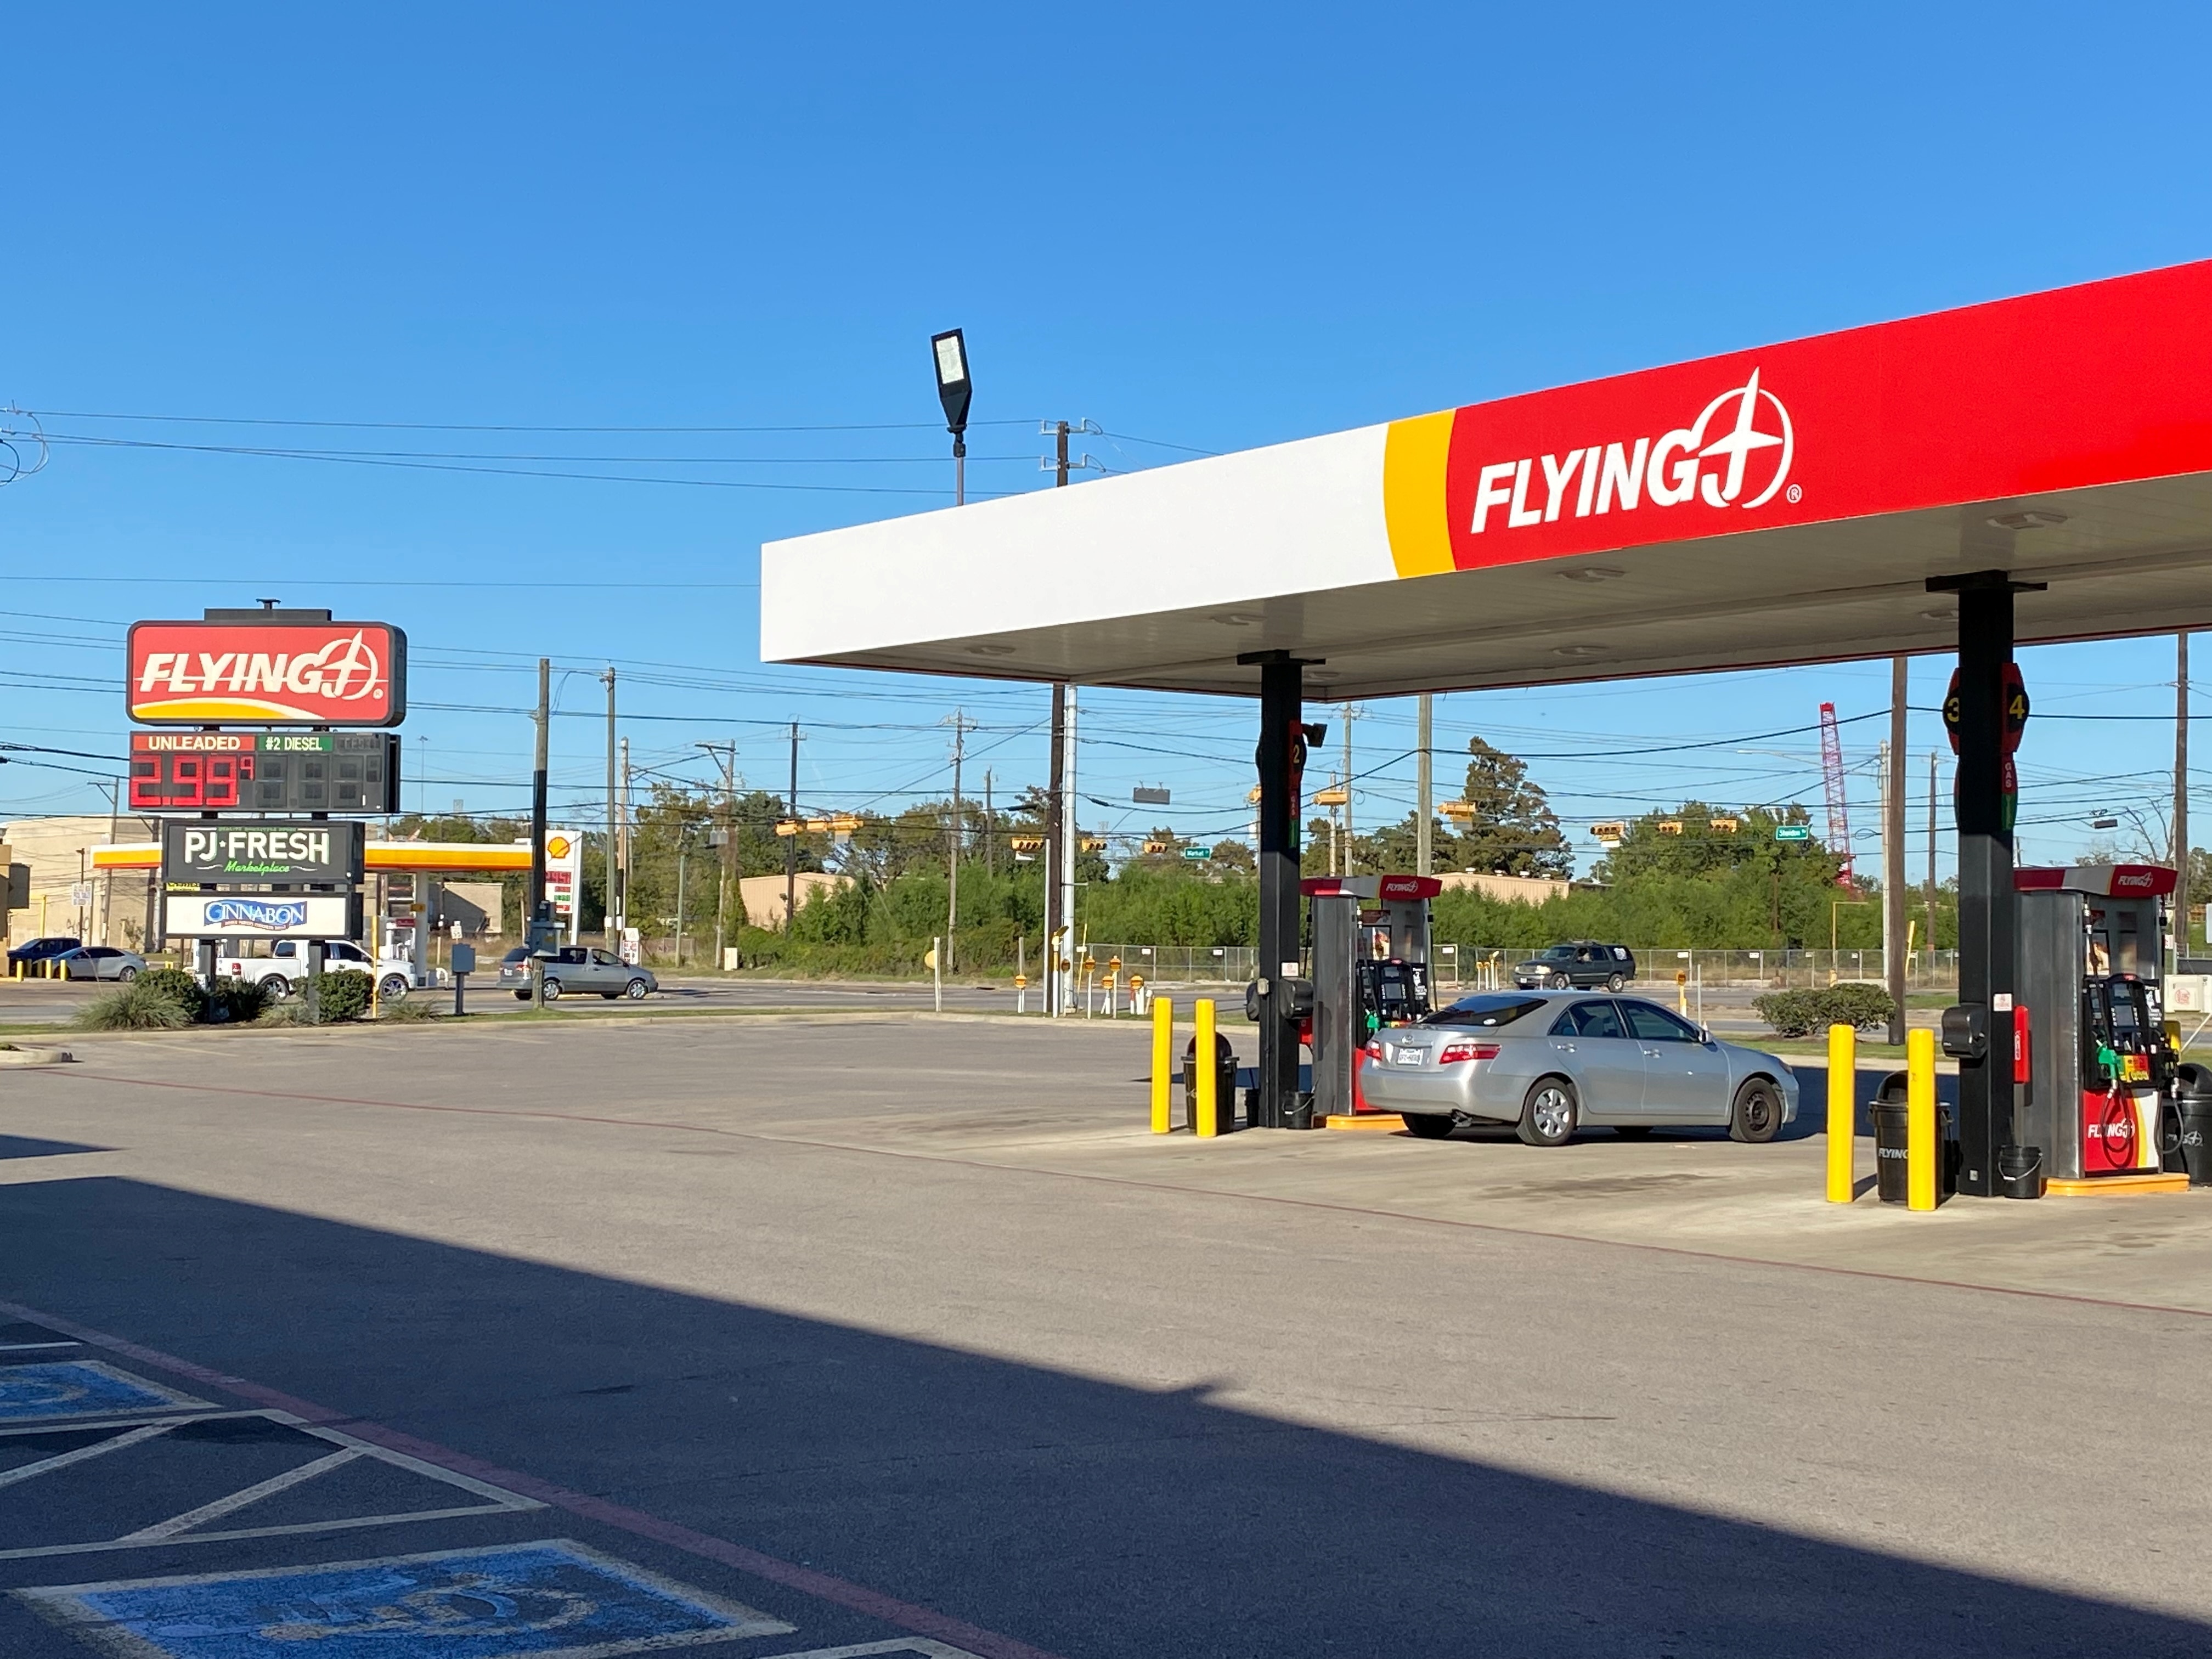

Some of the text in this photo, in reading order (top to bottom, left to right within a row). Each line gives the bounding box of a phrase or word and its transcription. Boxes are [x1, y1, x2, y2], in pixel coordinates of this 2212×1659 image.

[1948, 697, 1960, 723] 3
[2009, 695, 2025, 719] 4
[149, 736, 240, 750] UNLEADED
[266, 737, 281, 751] #2
[285, 737, 323, 751] DIESEL
[1293, 744, 1300, 764] 2
[228, 832, 329, 865] FRESH
[224, 860, 290, 876] Marketplace
[206, 901, 304, 924] CINNABON
